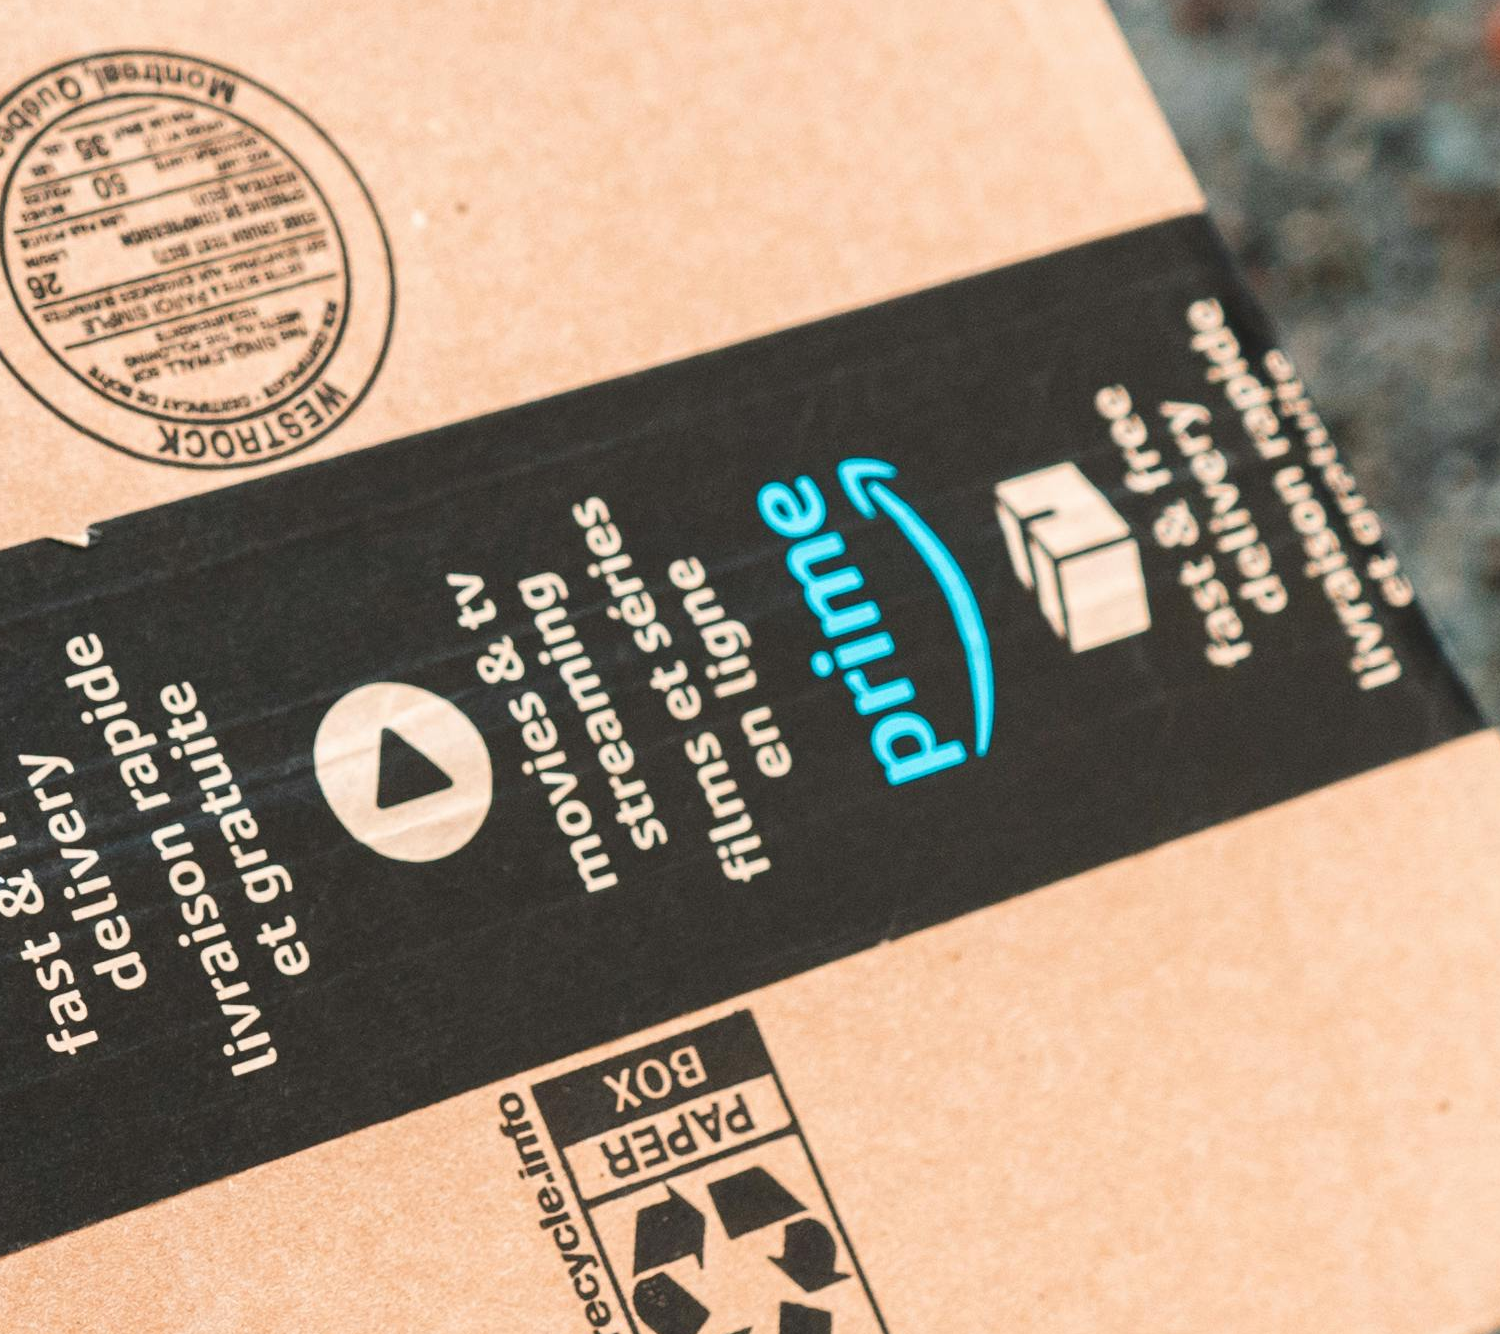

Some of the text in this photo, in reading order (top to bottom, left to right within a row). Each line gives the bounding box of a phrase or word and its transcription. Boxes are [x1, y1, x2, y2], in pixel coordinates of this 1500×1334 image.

[92, 172, 127, 200] 50
[158, 382, 349, 461] WESTROCK
[1096, 384, 1252, 667] fast & free
[1159, 400, 1288, 614] delivery
[1187, 297, 1401, 690] livraison rapide
[446, 573, 618, 893] movies & tv
[518, 572, 668, 851] streaming
[571, 495, 771, 884] films et séries
[667, 556, 793, 779] en ligne
[757, 474, 968, 786] prime
[19, 751, 148, 991] delivery
[65, 632, 279, 1077] livraison rapide
[160, 680, 310, 977] et gratuite
[20, 931, 99, 1056] fast
[602, 1045, 708, 1113] BOX
[600, 1092, 755, 1179] PAPER
